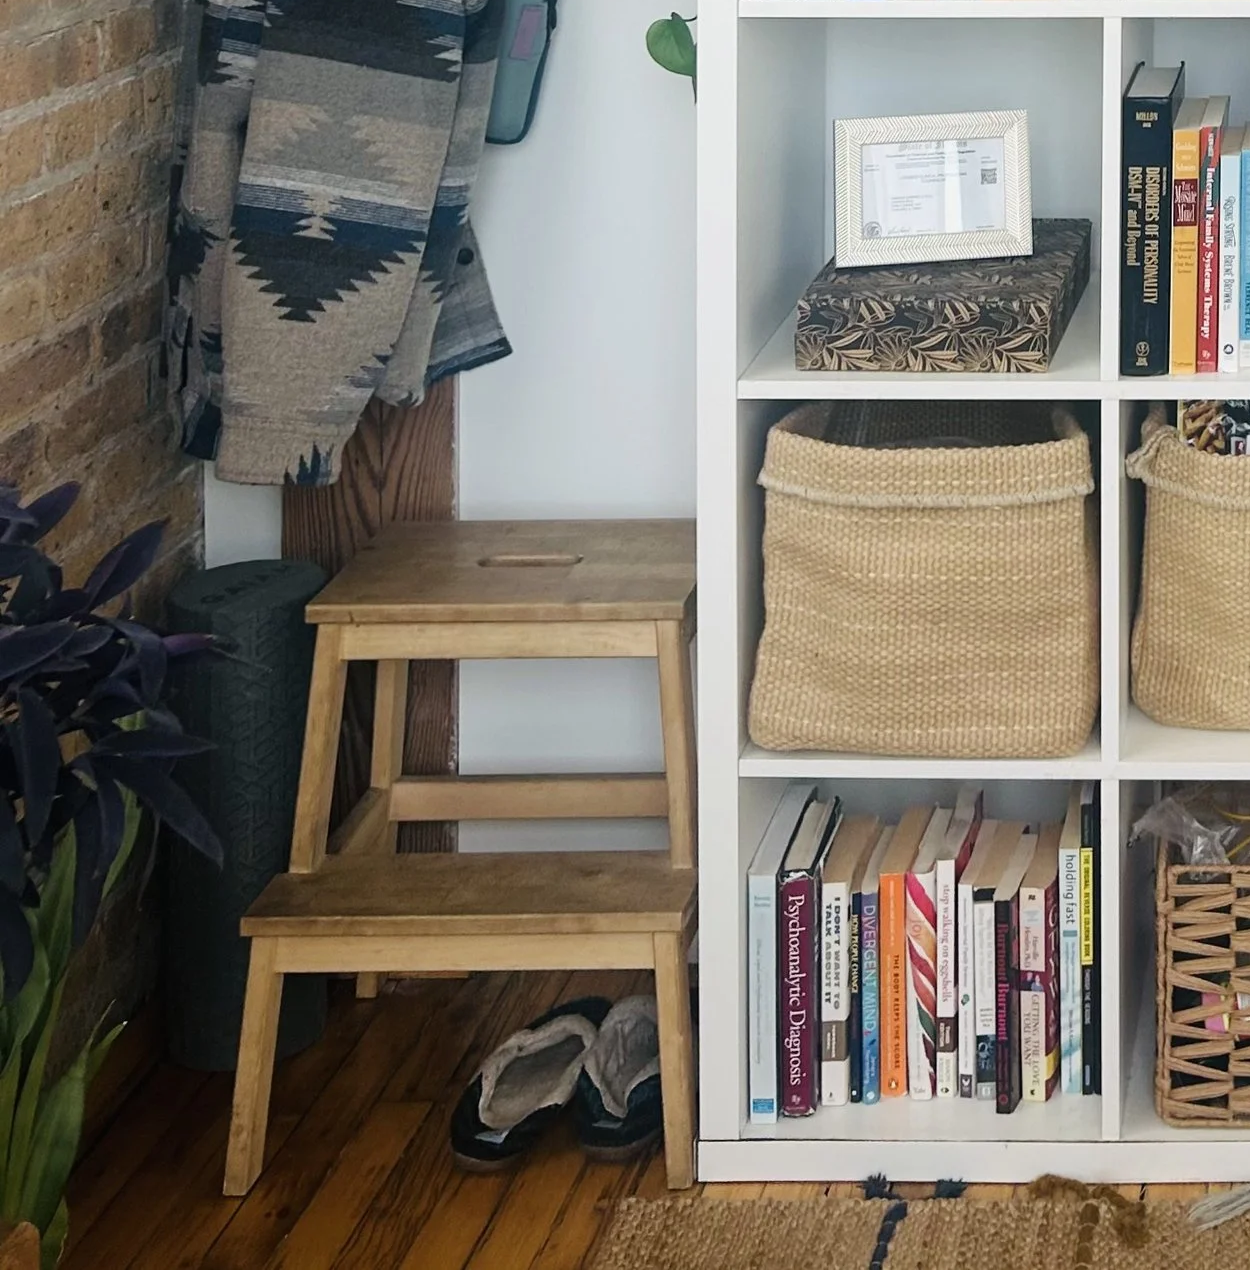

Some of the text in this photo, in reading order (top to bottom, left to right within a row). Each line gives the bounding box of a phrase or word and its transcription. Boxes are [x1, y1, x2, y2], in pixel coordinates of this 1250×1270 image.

[1127, 209, 1140, 227] and
[1143, 167, 1160, 304] DISORDERS OF PERSONALITY
[1125, 230, 1141, 266] Beyond
[1201, 167, 1215, 339] Internal Family Systems Therapy
[1063, 855, 1077, 924] holding fast
[851, 936, 859, 961] PEOPLE
[909, 920, 923, 941] joy
[940, 885, 951, 1002] stop walking on eggshells
[784, 894, 807, 1086] Psychoanalytic Diagnosis
[851, 963, 859, 993] CHANGE
[863, 905, 876, 1031] DIVERGENT MIND
[998, 923, 1009, 1041] Burnout Burnout
[825, 992, 831, 1004] IT
[834, 993, 840, 1010] TO
